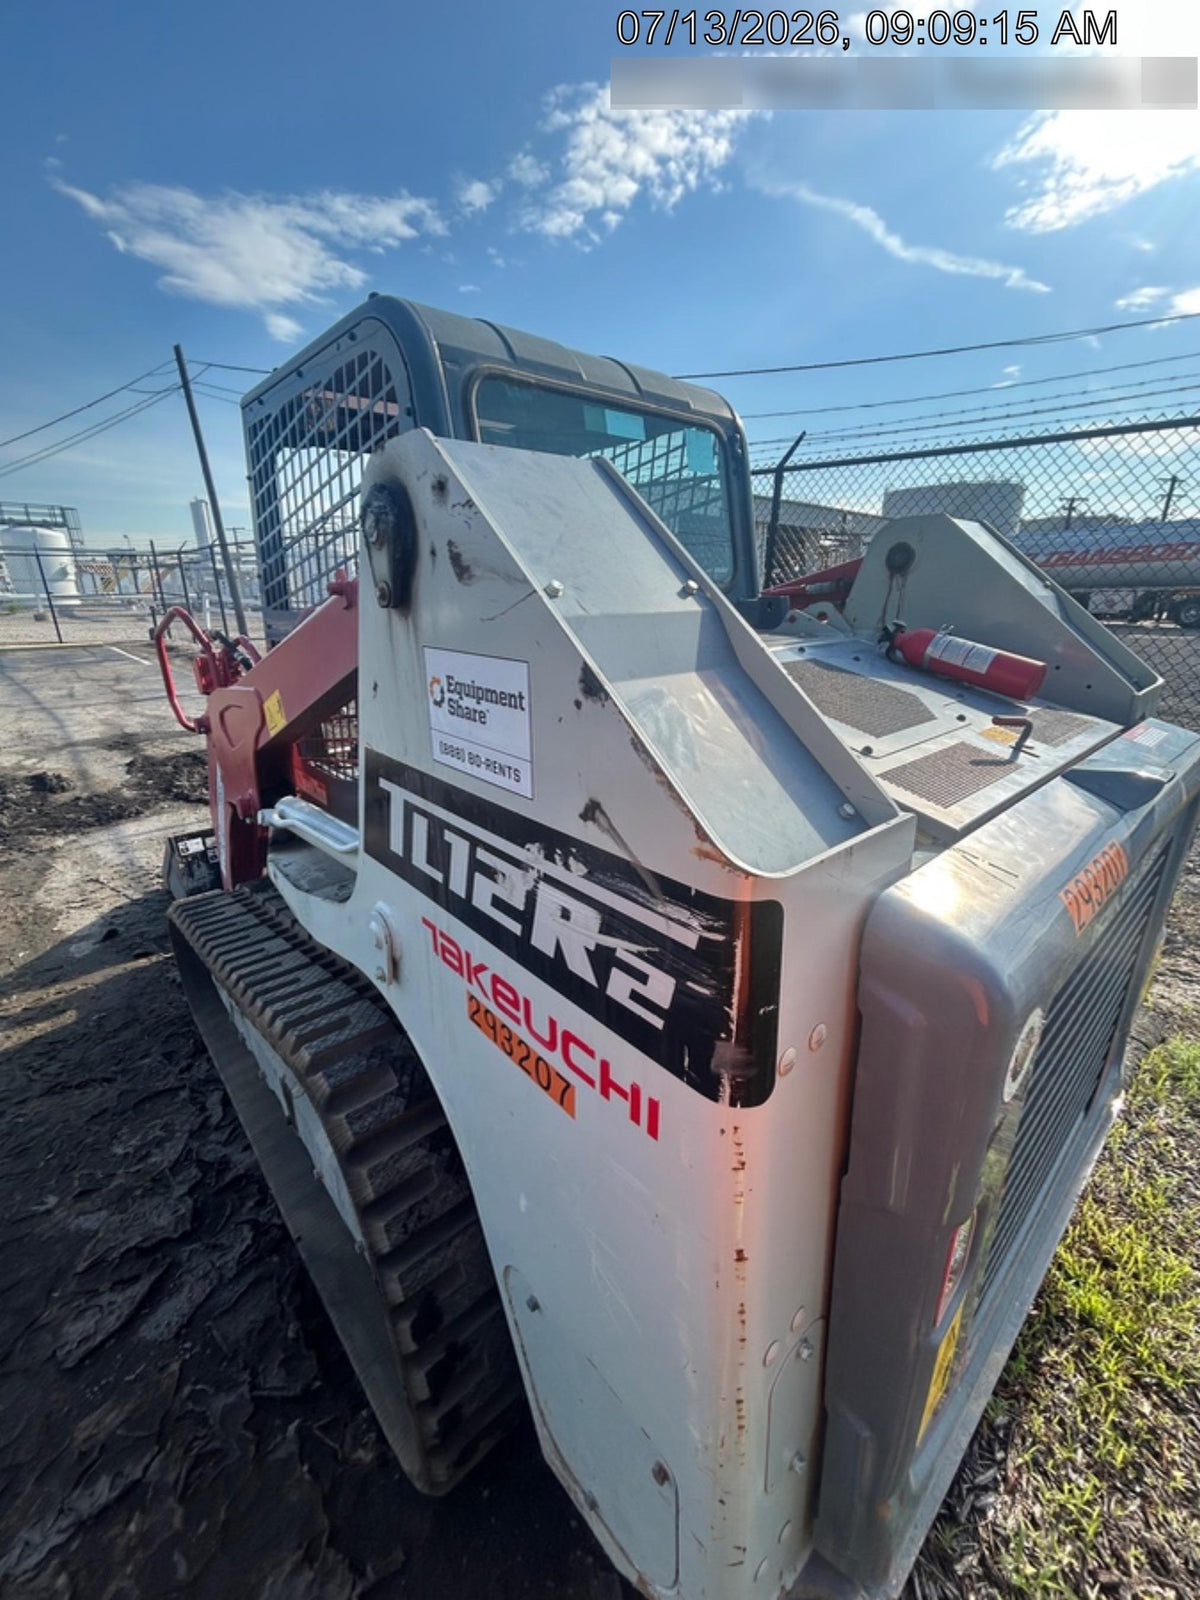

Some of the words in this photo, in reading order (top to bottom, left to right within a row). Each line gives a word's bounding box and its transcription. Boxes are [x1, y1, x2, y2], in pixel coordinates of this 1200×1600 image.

[445, 675, 526, 712] Equipment
[447, 698, 488, 725] Share
[467, 751, 522, 783] 80-RENTS
[1063, 841, 1125, 931] 293207
[469, 994, 571, 1107] 293207
